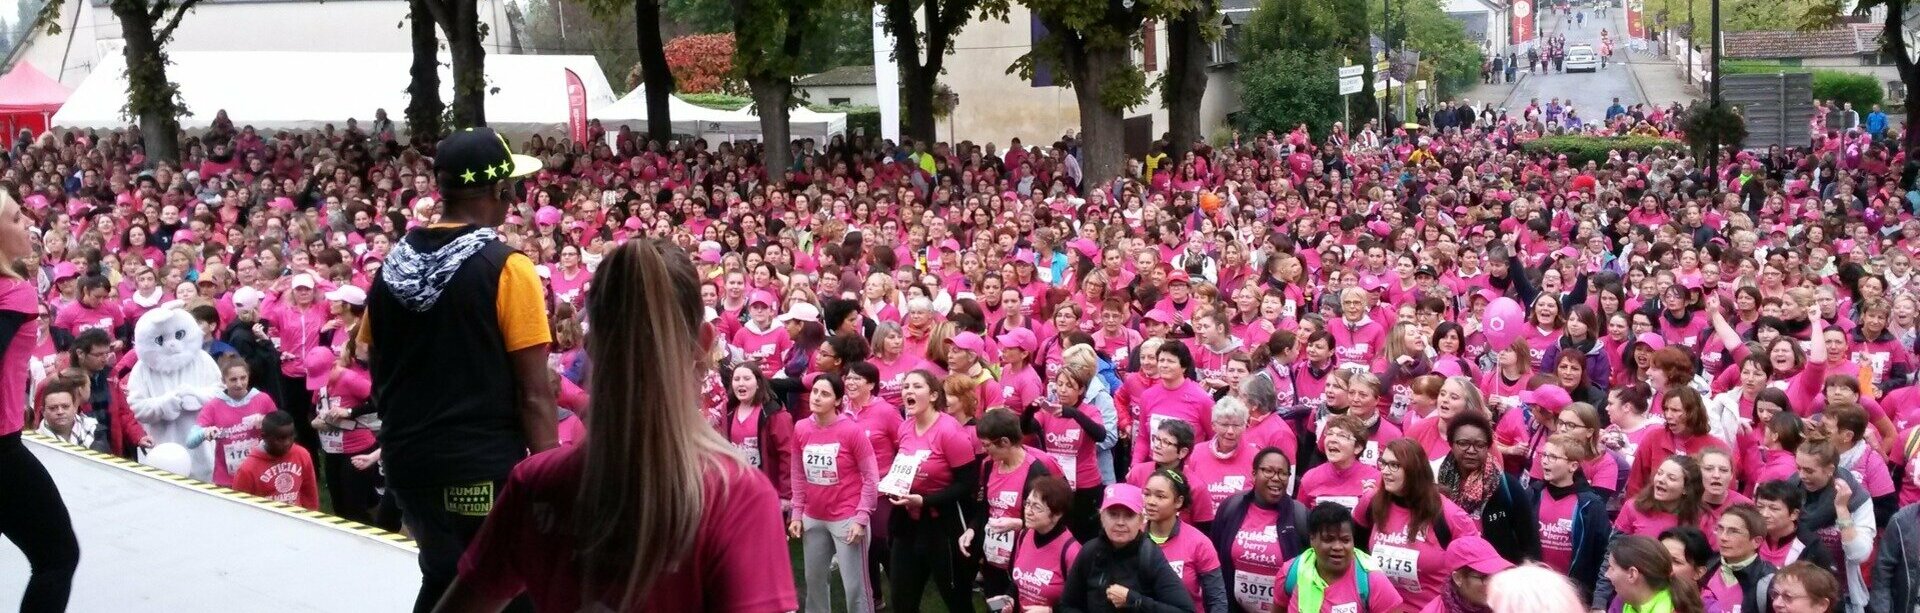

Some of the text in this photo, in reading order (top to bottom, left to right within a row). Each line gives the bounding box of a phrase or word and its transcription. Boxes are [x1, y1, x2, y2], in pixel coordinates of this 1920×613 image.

[807, 455, 833, 466] 2713
[260, 462, 302, 483] OFFICIAL
[449, 486, 489, 496] ZUMBA
[449, 502, 489, 512] NATION
[1377, 556, 1412, 573] 3175
